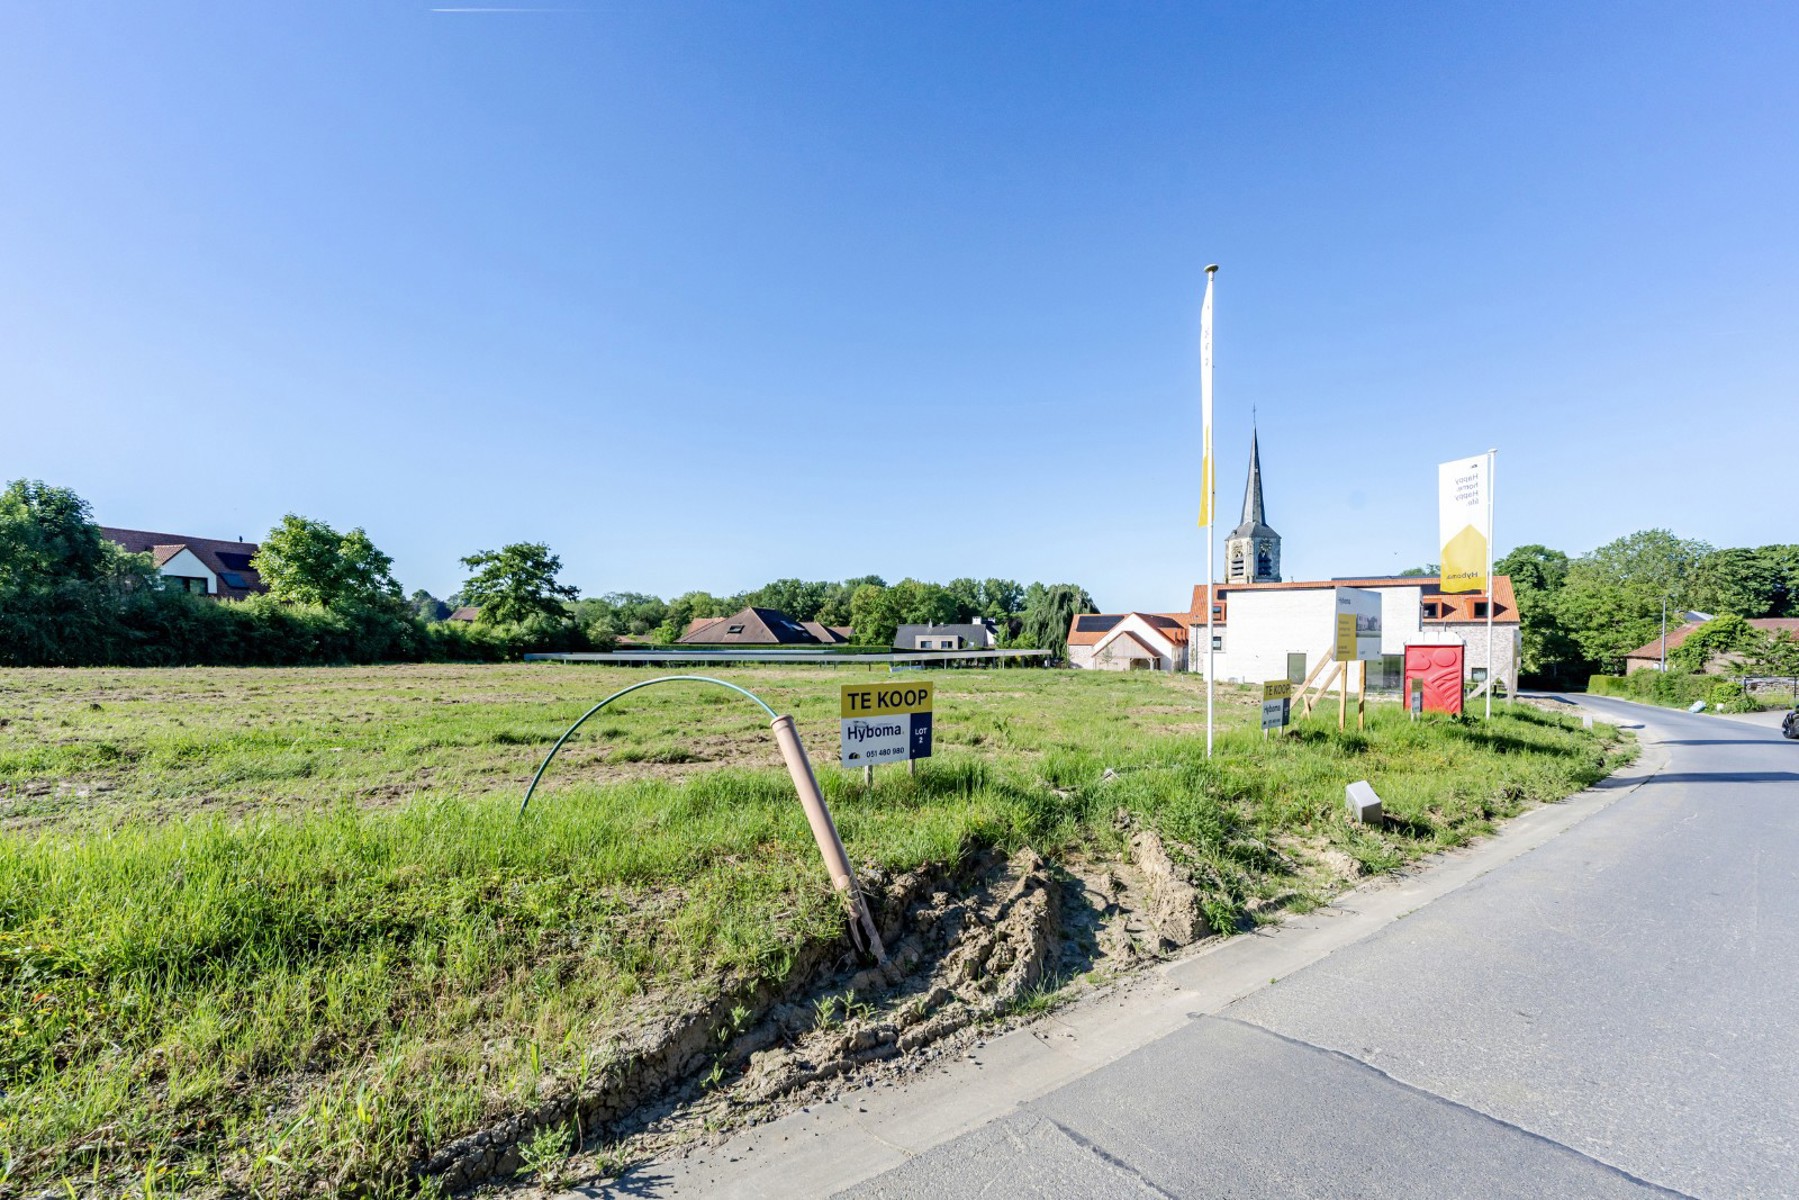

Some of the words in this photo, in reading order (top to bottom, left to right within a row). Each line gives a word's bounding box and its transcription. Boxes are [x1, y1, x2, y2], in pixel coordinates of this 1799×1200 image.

[1265, 685, 1273, 696] TE
[1273, 684, 1290, 695] KOOP
[847, 692, 872, 710] TE
[877, 689, 928, 709] KOOP
[914, 727, 928, 735] LOT
[878, 748, 891, 756] 480
[892, 747, 905, 755] 980
